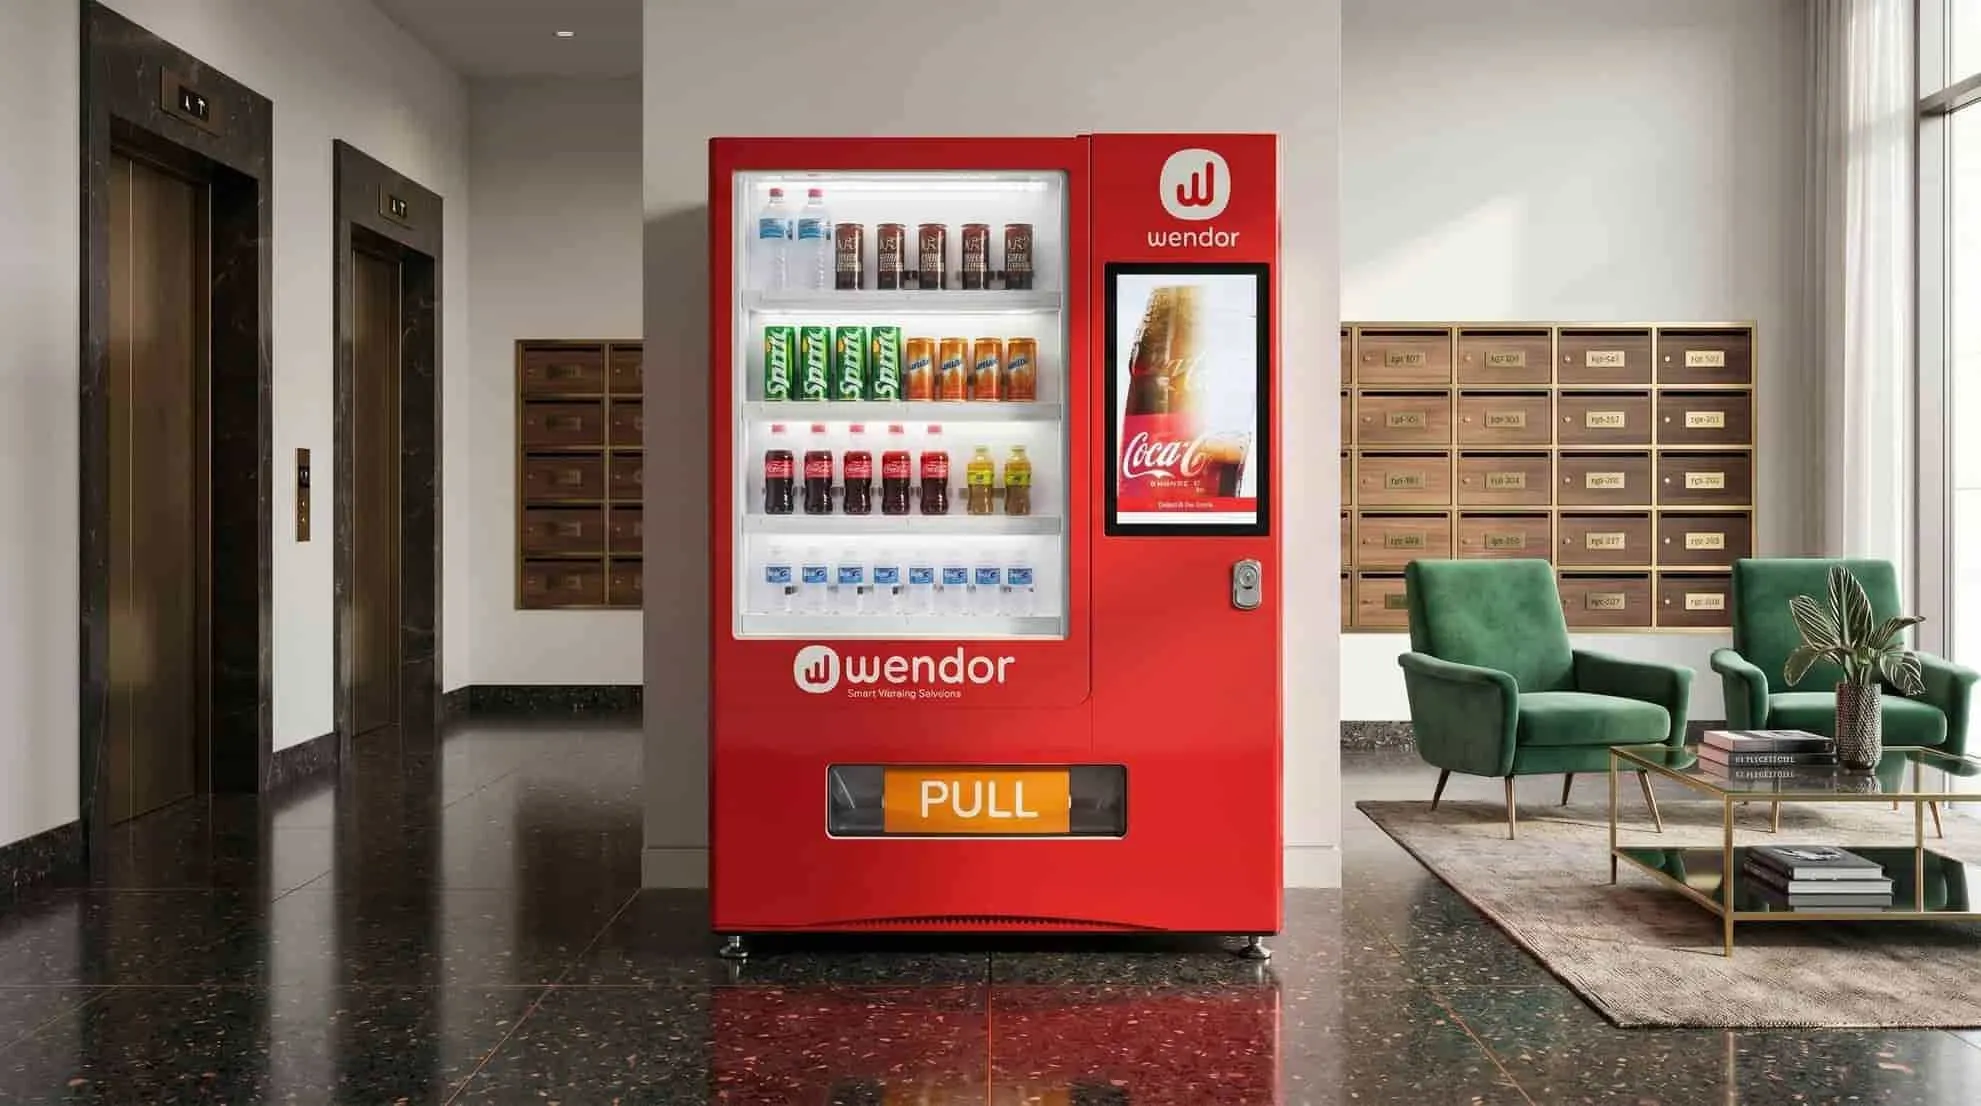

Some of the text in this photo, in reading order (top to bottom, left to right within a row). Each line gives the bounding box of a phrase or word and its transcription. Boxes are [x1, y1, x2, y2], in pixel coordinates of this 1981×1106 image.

[1147, 226, 1240, 248] wendor
[846, 646, 1016, 684] wendor
[847, 689, 876, 698] Smart
[920, 780, 1039, 819] PULL
